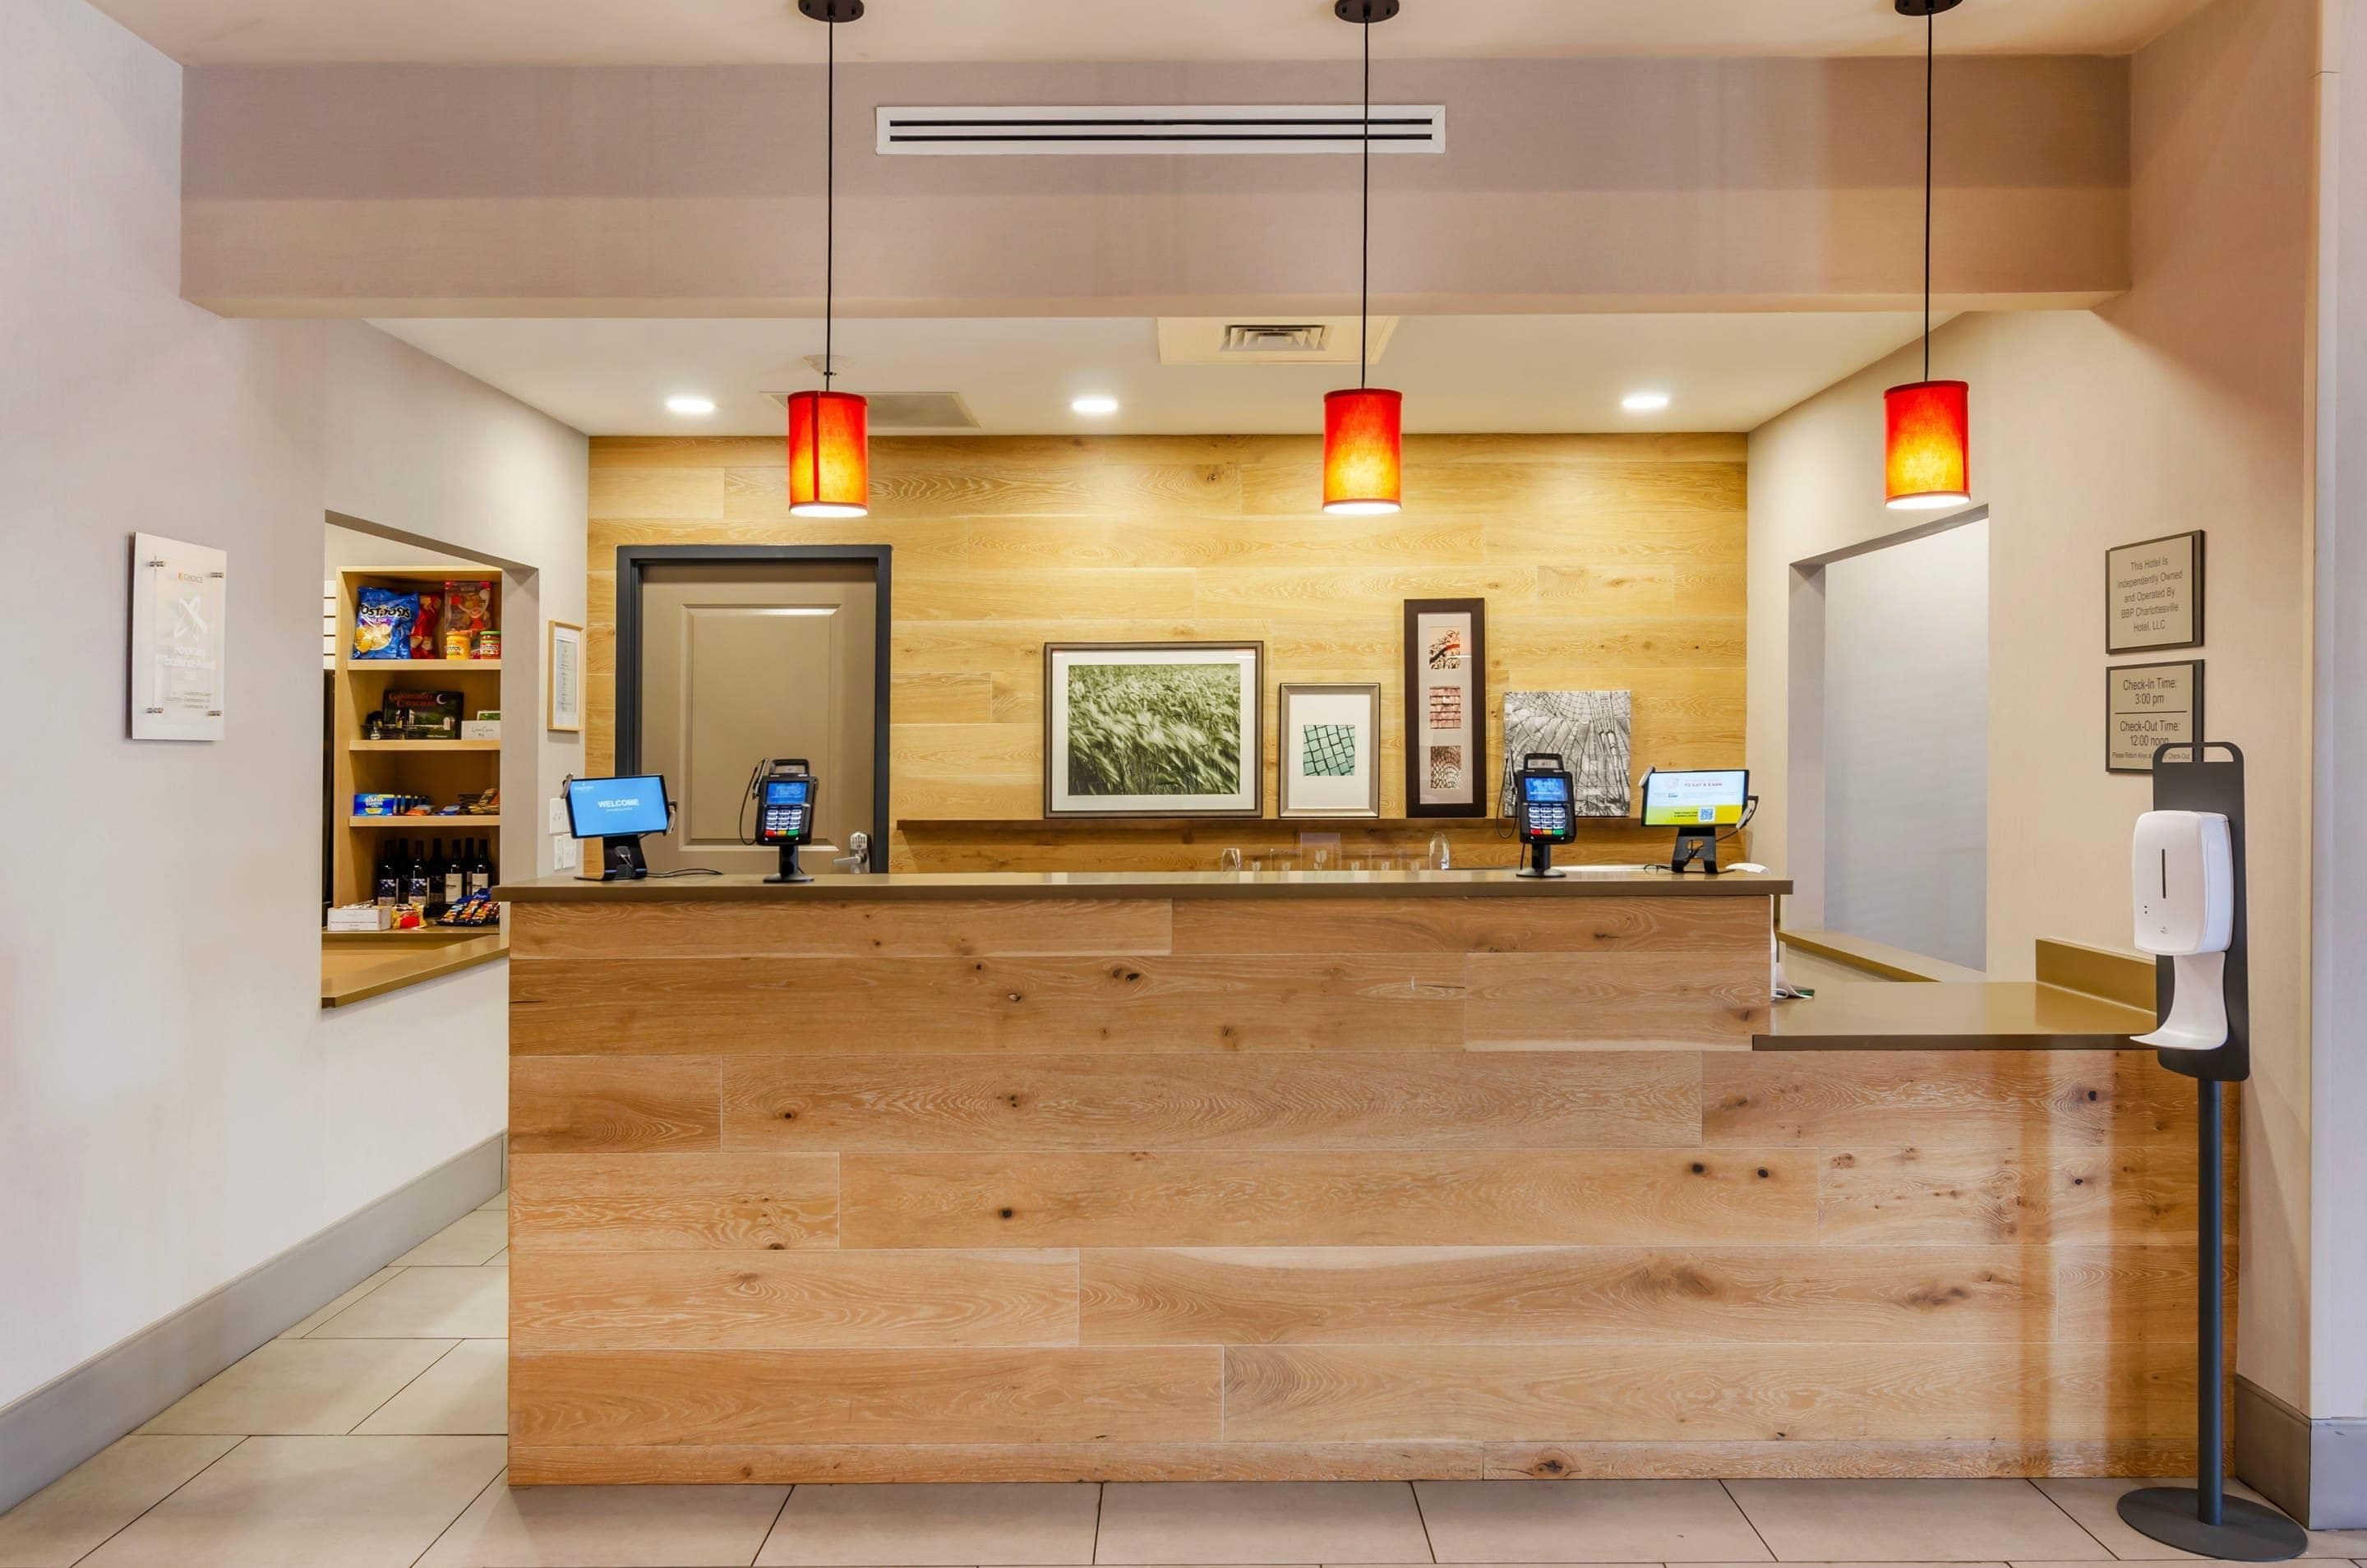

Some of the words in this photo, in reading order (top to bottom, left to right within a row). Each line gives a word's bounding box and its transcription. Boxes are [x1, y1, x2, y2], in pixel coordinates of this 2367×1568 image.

[2130, 560, 2143, 572] This
[2145, 558, 2161, 569] Hotel
[2162, 556, 2168, 565] Is
[2117, 574, 2159, 589] Independently
[2160, 570, 2183, 582] Owned
[2124, 592, 2135, 603] and
[2137, 589, 2165, 602] Operated
[2166, 587, 2175, 598] By
[2120, 607, 2134, 618] BBP
[2135, 602, 2179, 616] Charlottesville
[2152, 619, 2166, 630] LLC
[2124, 678, 2154, 690] Check-In
[2157, 677, 2177, 689] Time:
[2135, 694, 2150, 704] 3:00
[2152, 694, 2165, 707] pm
[2120, 720, 2158, 732] Check-Out
[2159, 720, 2180, 731] Time:
[2130, 735, 2148, 746] 12:00
[2150, 738, 2169, 746] noon
[598, 799, 639, 809] WELCOME
